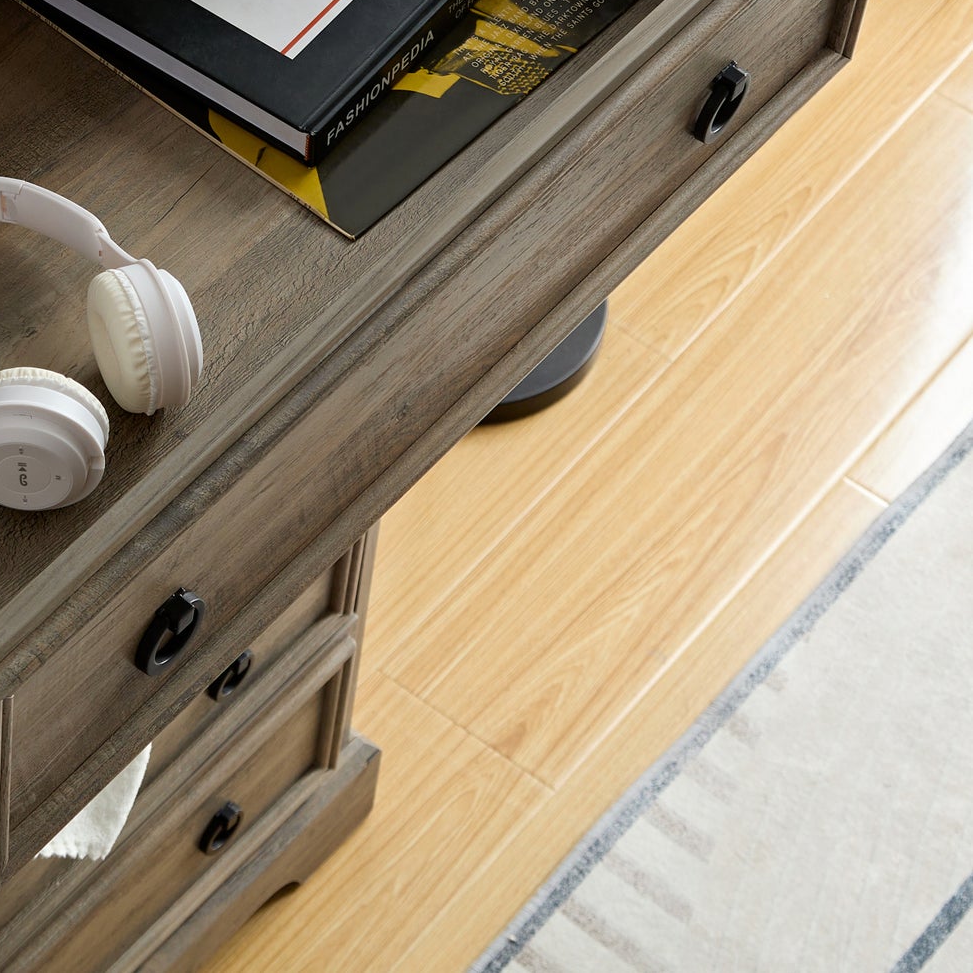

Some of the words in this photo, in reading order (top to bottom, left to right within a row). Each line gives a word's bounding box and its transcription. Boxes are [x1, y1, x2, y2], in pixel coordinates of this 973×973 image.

[534, 31, 551, 43] THE
[551, 28, 568, 42] THE
[567, 7, 593, 29] SAINTS
[327, 30, 434, 146] FASHIONPEDIA
